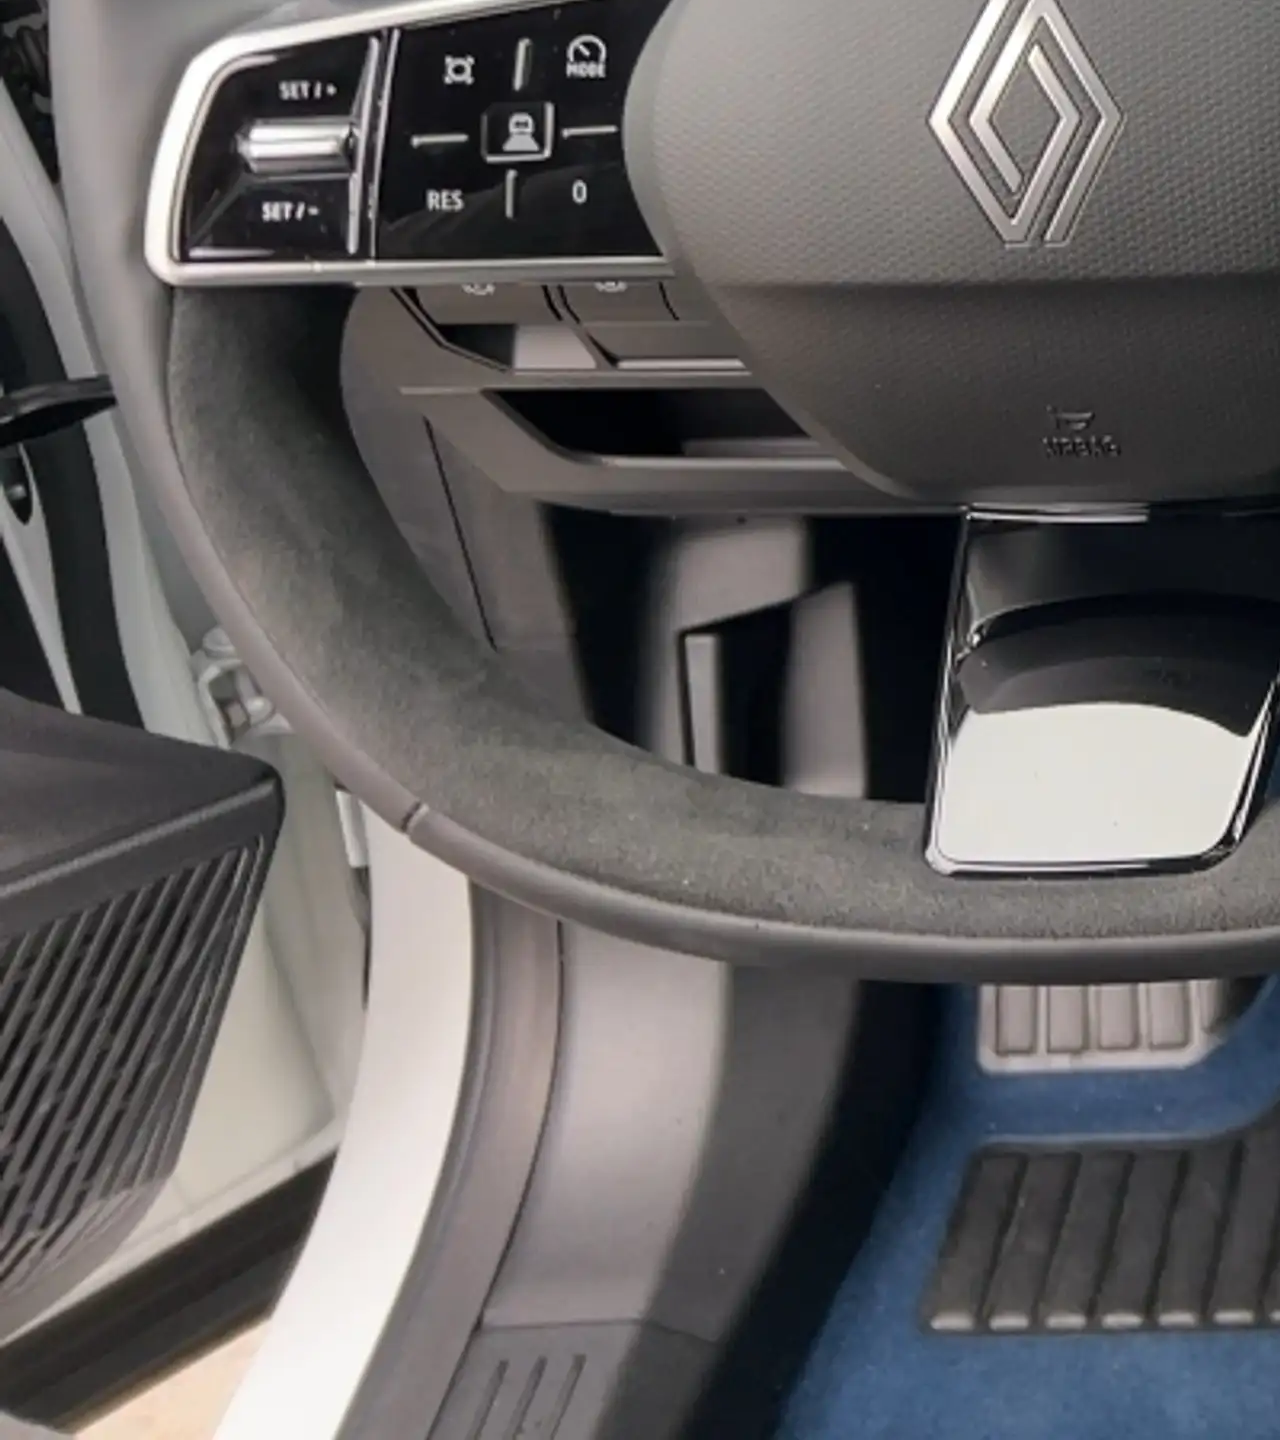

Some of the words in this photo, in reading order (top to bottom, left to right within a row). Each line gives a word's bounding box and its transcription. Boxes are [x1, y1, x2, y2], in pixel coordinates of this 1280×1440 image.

[566, 62, 607, 78] MODE
[279, 81, 310, 100] SET
[426, 189, 465, 212] RES
[261, 201, 290, 221] SET
